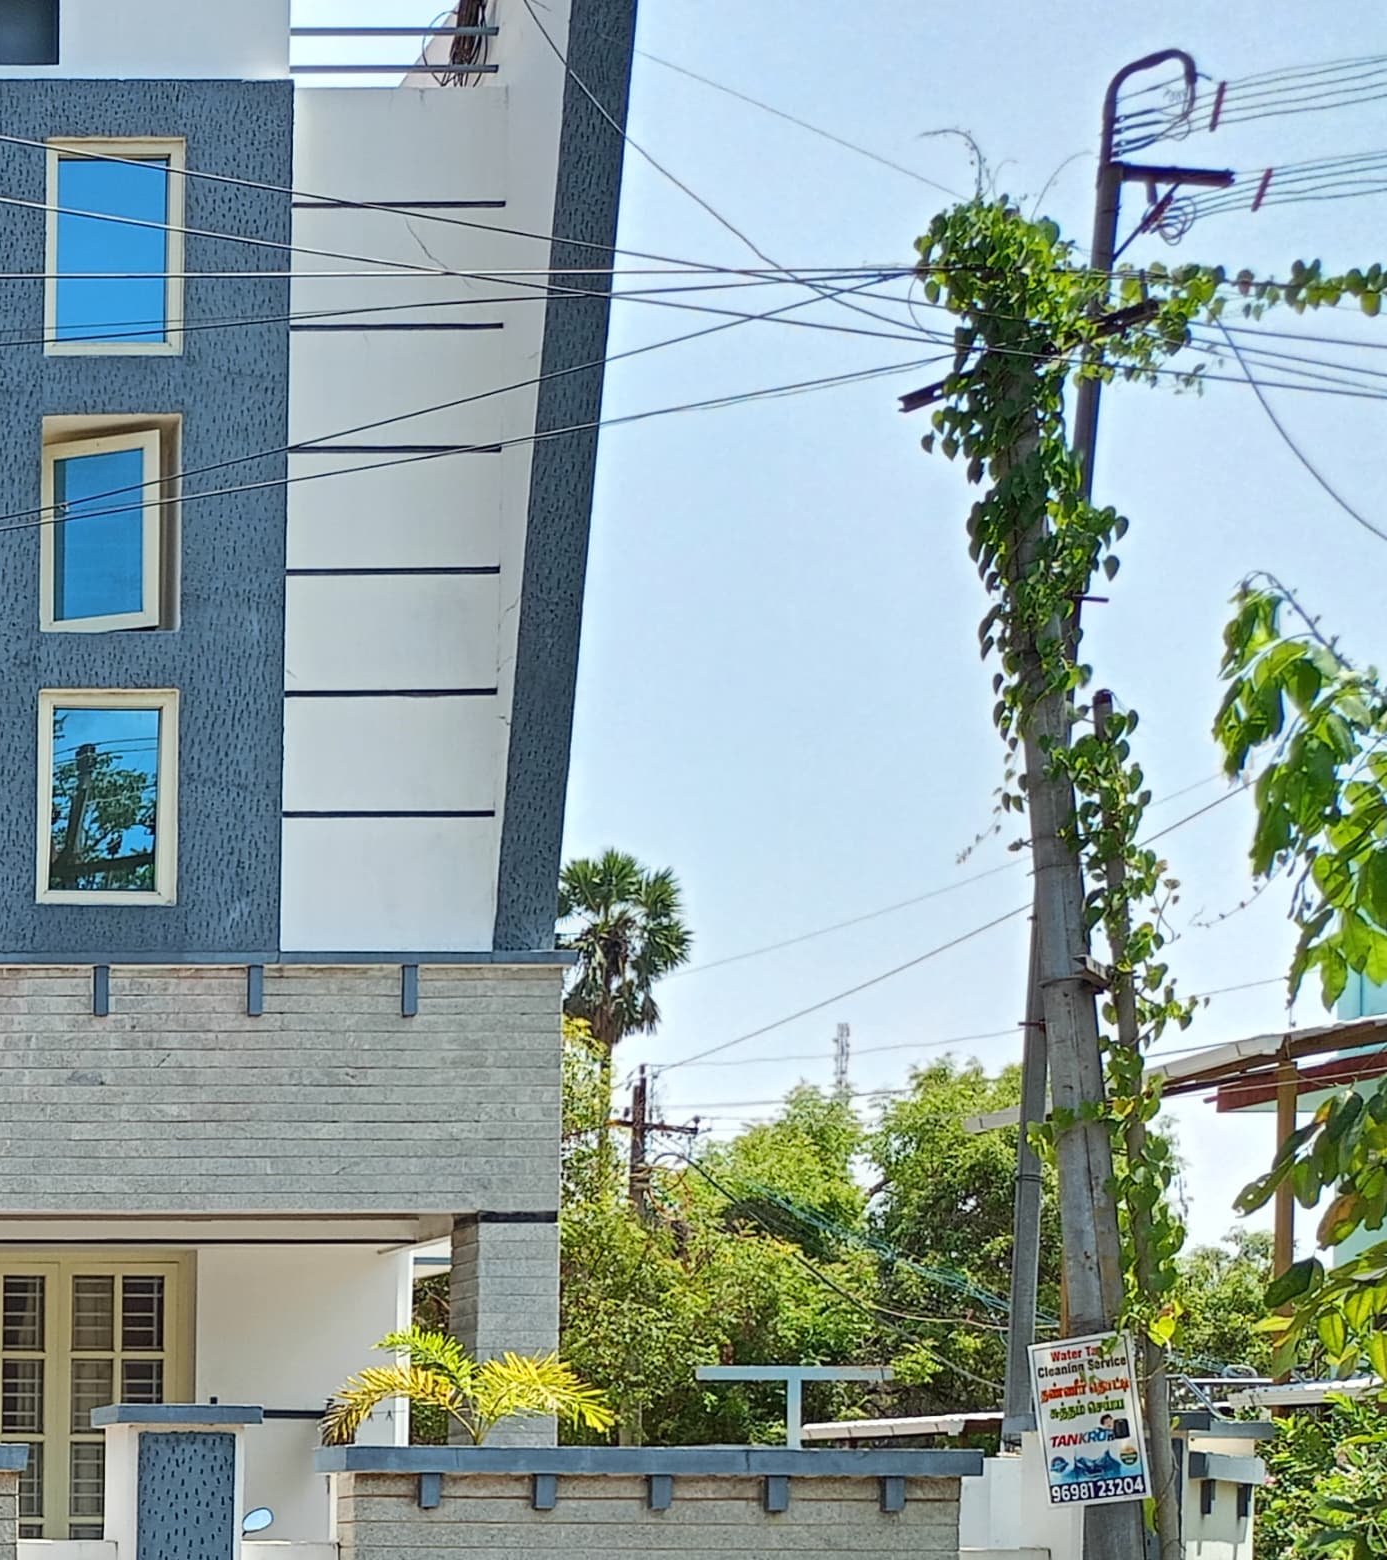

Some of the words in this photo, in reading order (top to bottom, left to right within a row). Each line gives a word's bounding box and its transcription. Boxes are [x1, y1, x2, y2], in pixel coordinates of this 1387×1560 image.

[1051, 1349, 1082, 1362] Water
[1038, 1362, 1085, 1378] Cleaning
[1088, 1356, 1127, 1371] Service
[1052, 1482, 1095, 1502] 96981
[1097, 1477, 1144, 1497] 23204
